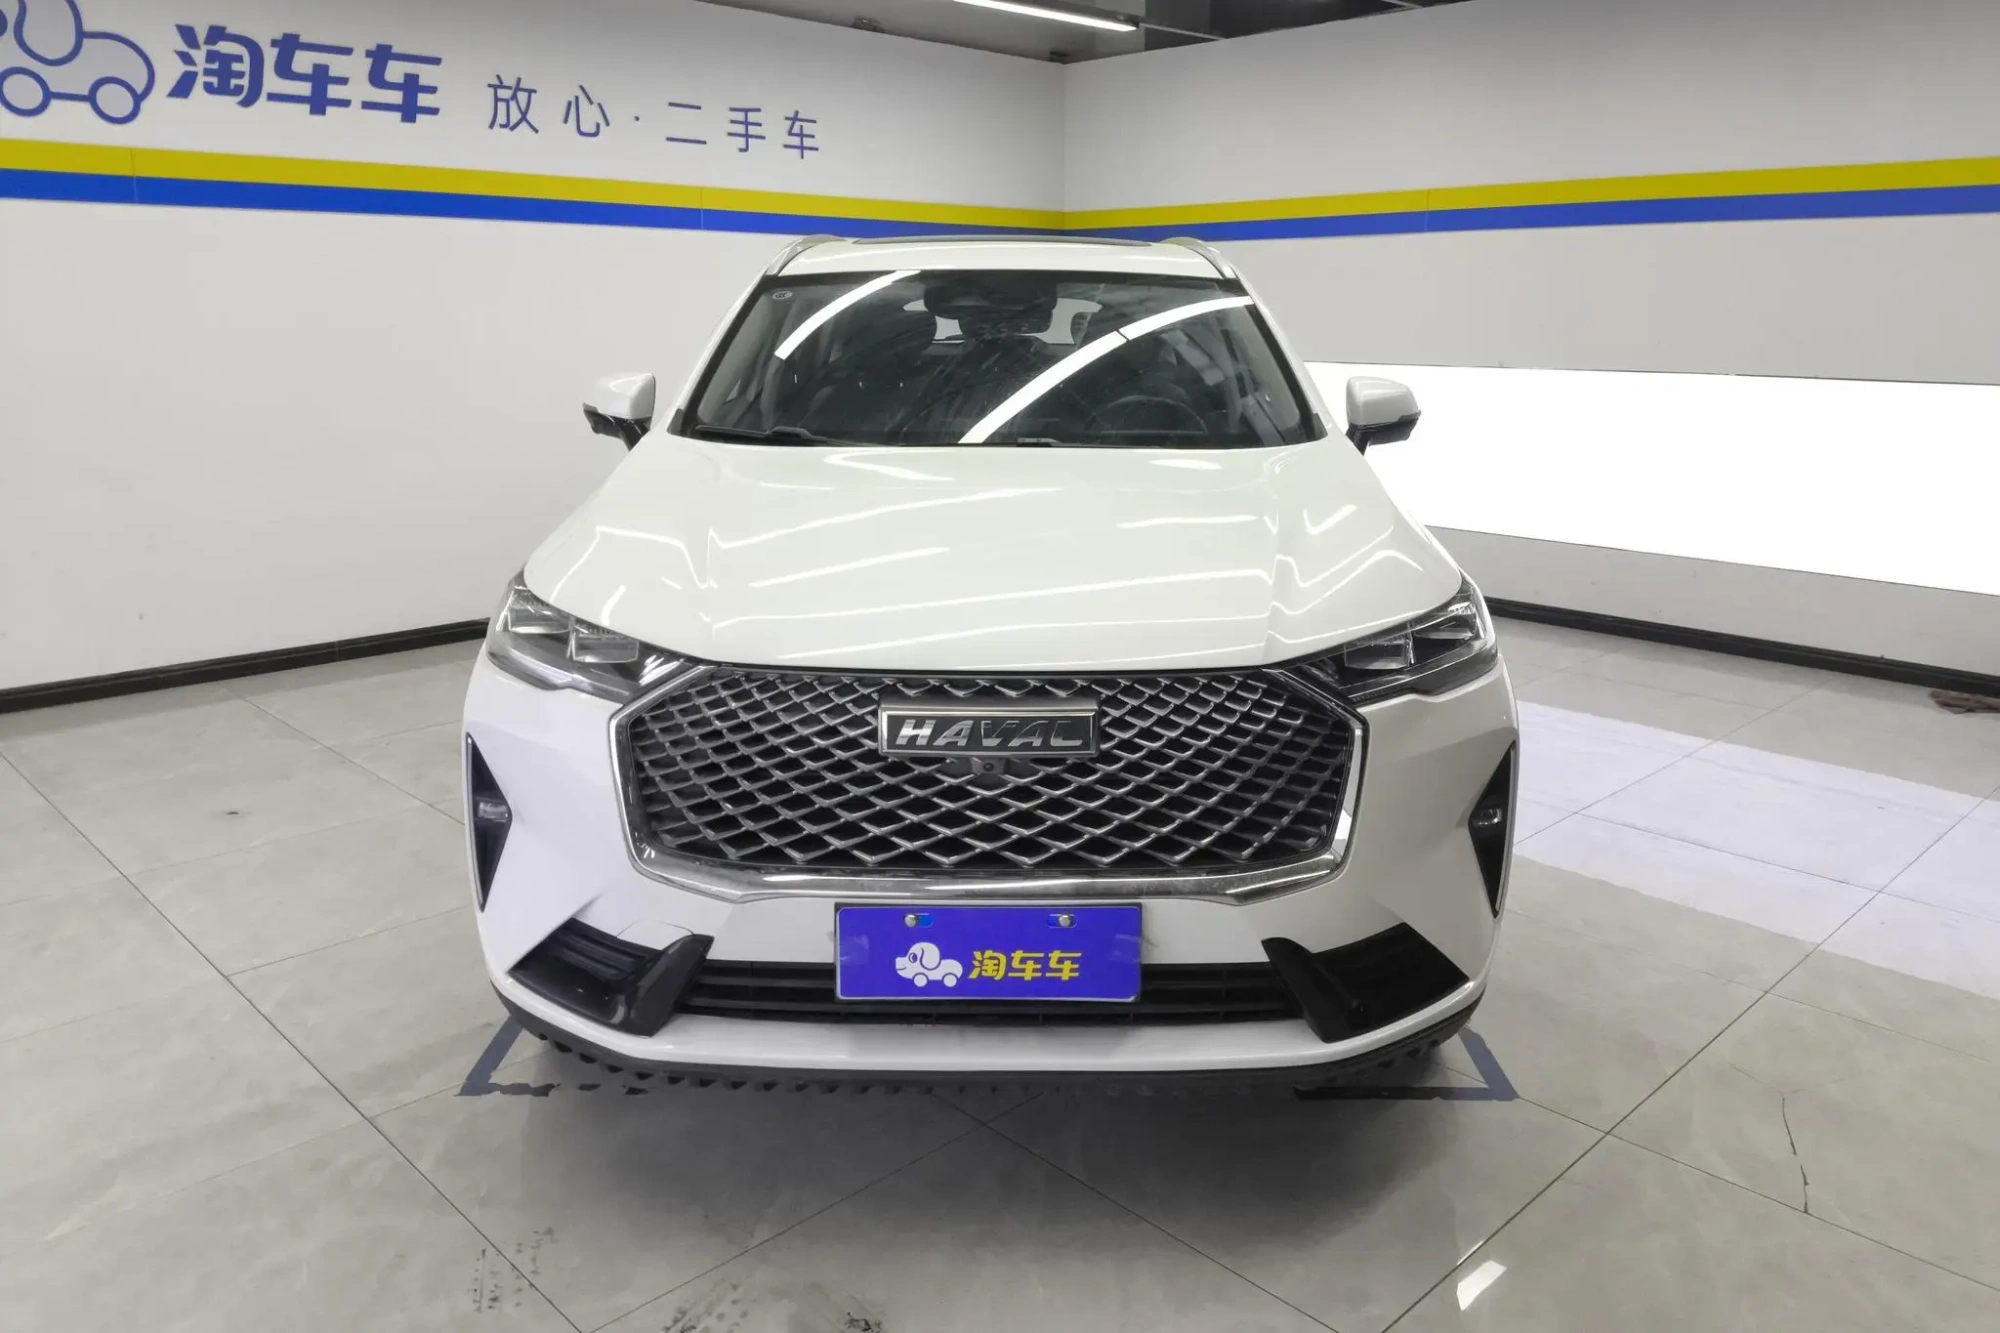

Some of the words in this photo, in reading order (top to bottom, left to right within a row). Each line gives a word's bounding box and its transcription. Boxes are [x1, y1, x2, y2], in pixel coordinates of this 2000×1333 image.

[167, 24, 442, 124] 淘车车
[969, 949, 1082, 980] 淘车车
